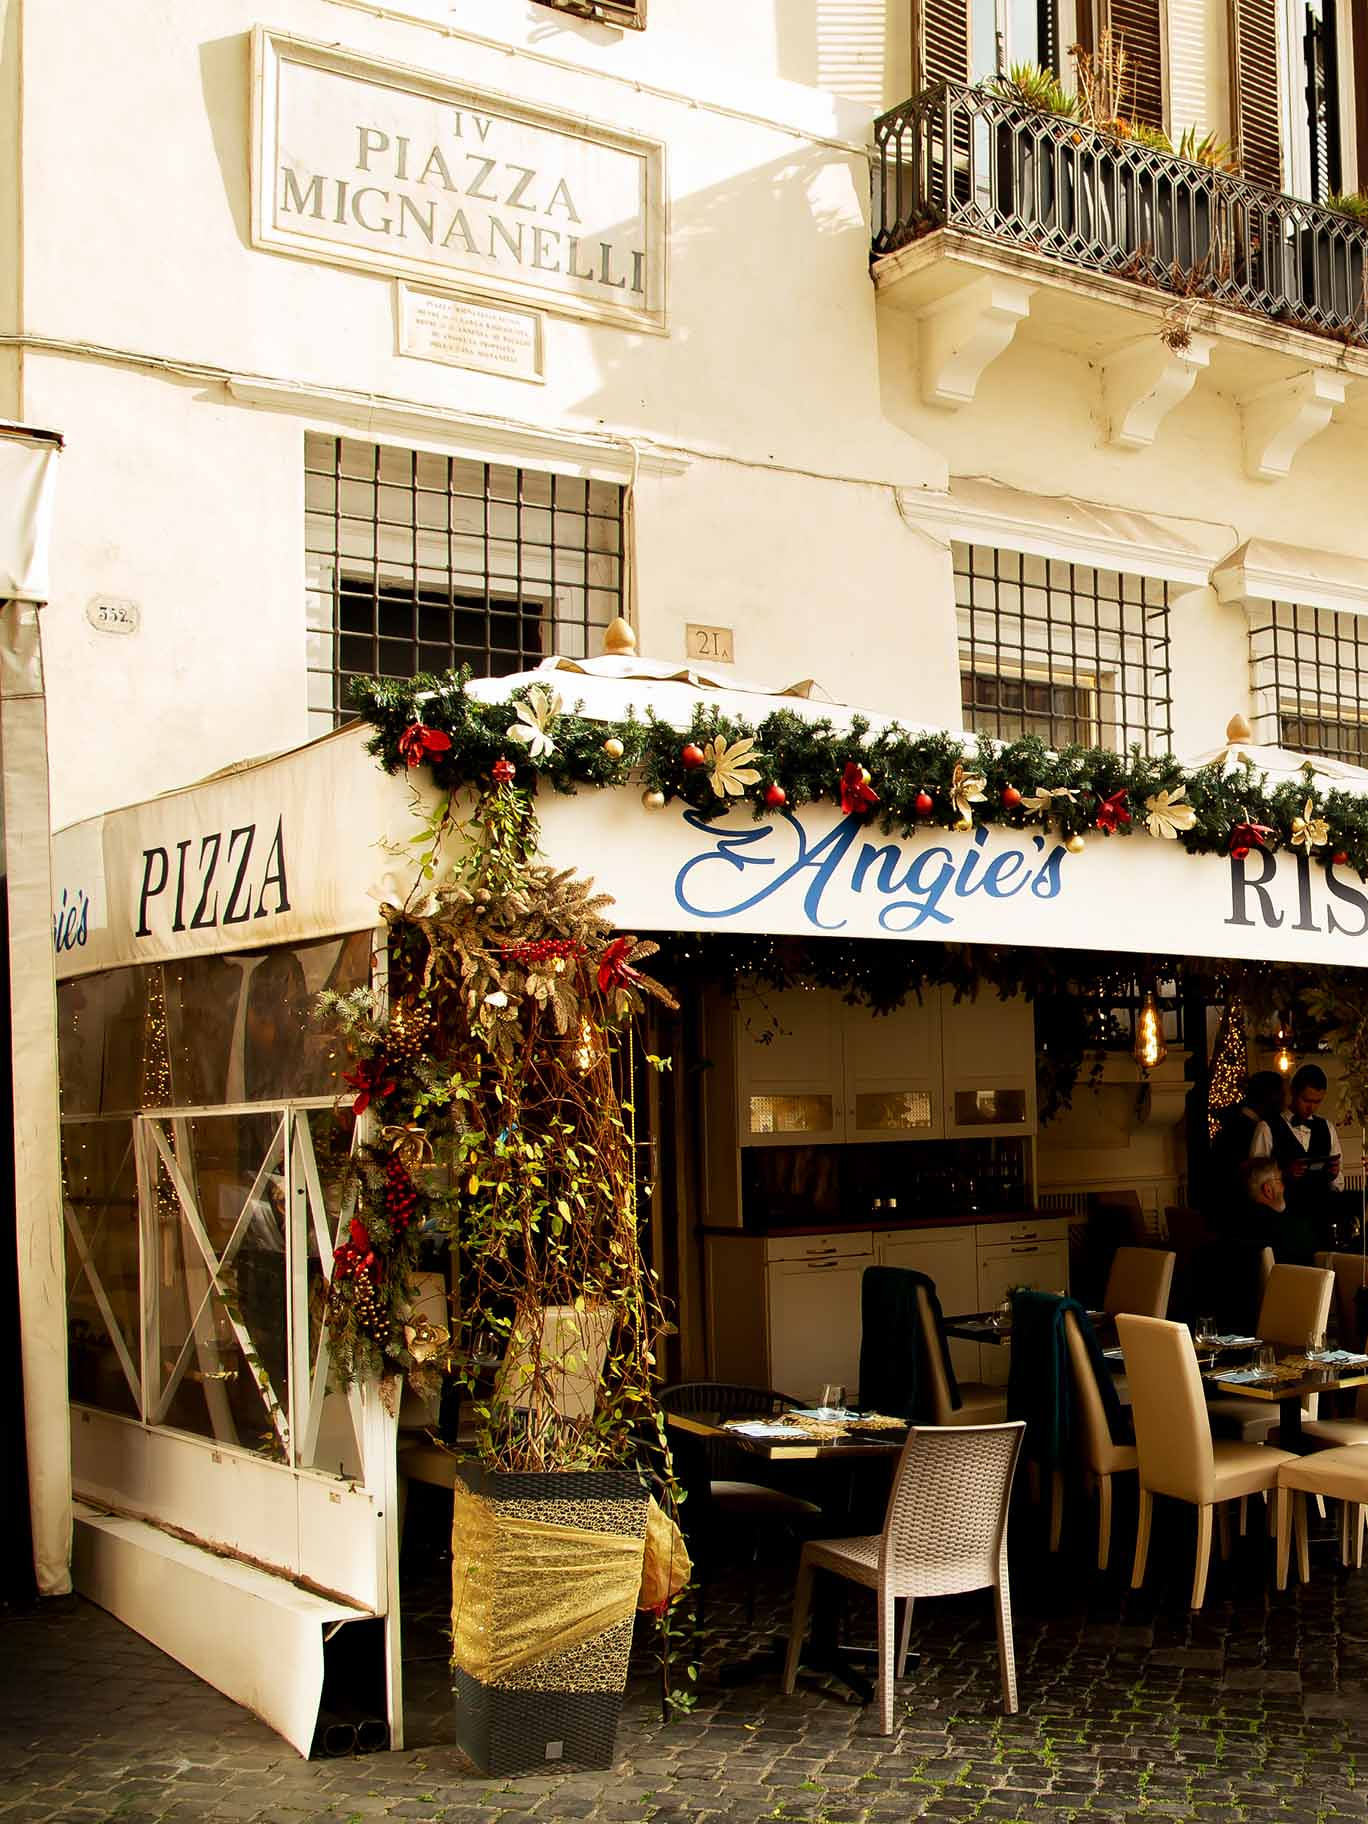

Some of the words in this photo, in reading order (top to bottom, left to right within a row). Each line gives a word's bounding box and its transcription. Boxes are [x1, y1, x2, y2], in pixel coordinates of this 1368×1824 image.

[354, 125, 582, 225] PIAZZA
[452, 111, 493, 144] IV
[279, 166, 646, 295] MIGNANELLI
[53, 888, 89, 953] ie's
[135, 812, 291, 938] PIZZA
[675, 807, 1068, 932] Angie's
